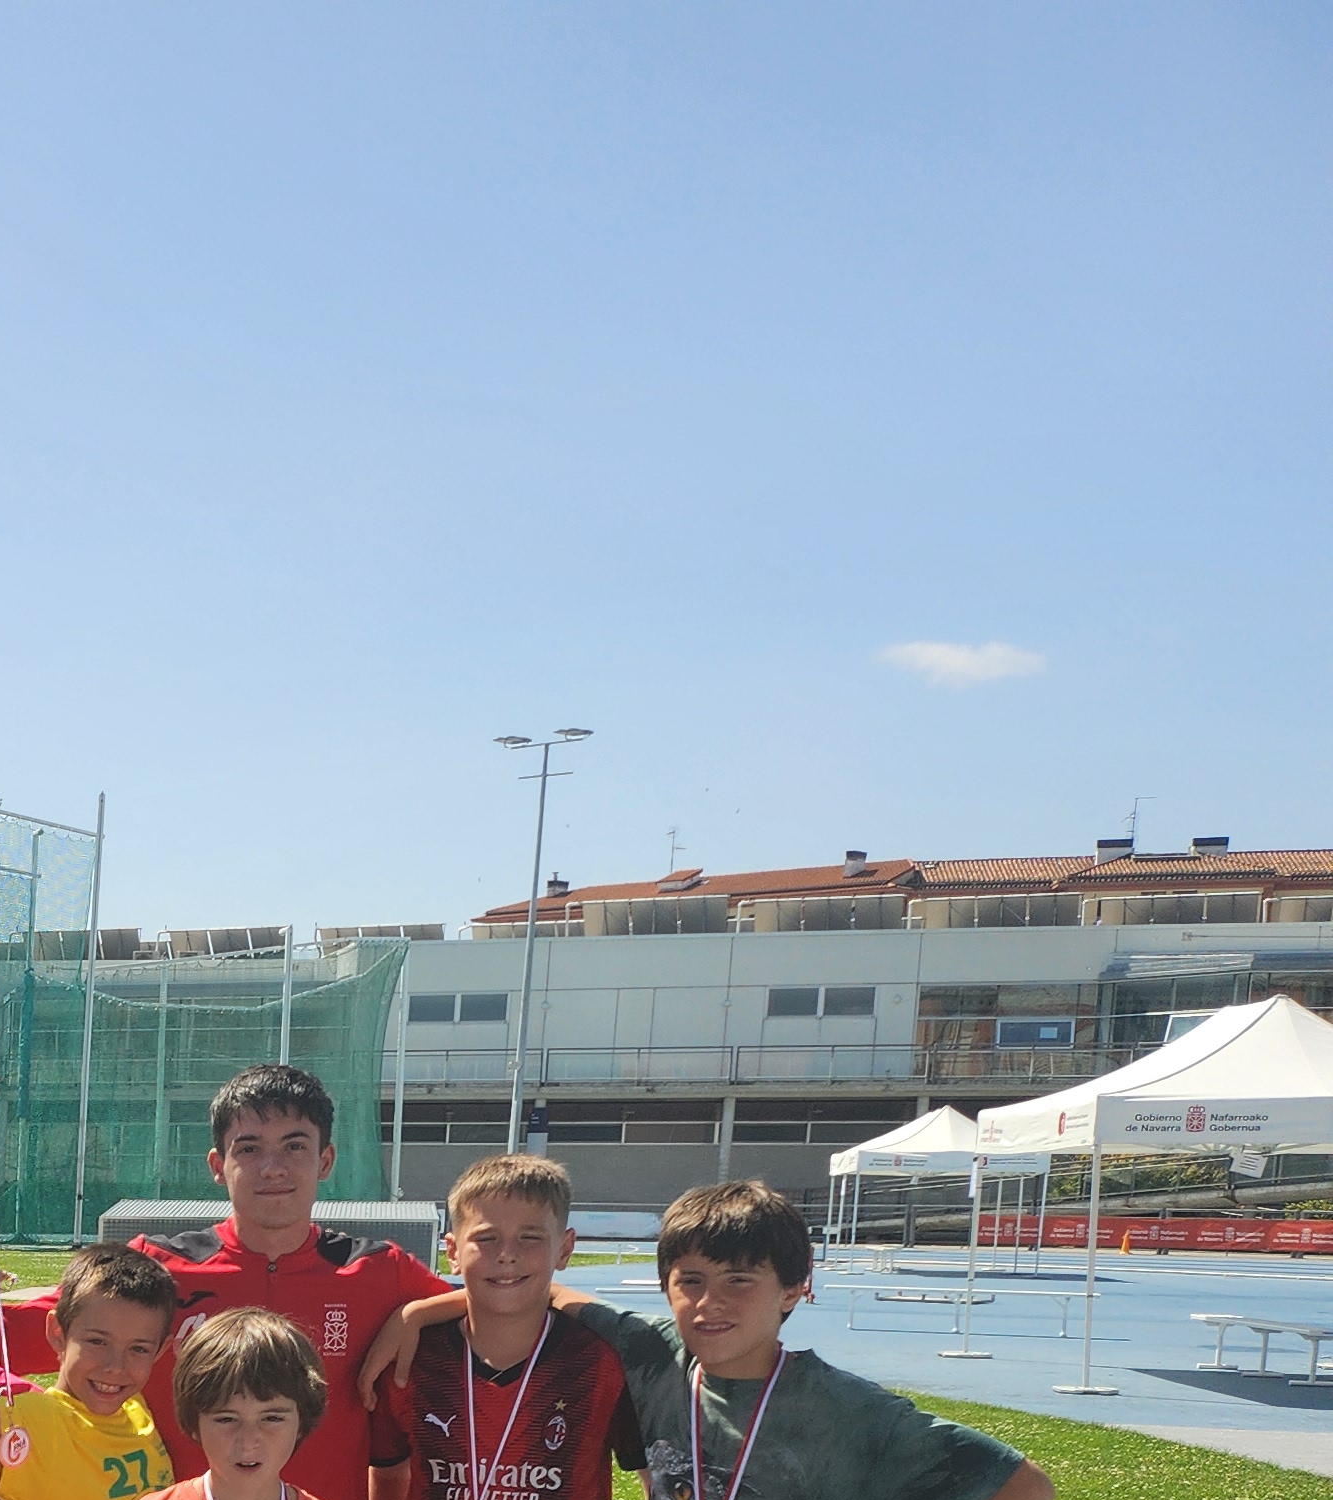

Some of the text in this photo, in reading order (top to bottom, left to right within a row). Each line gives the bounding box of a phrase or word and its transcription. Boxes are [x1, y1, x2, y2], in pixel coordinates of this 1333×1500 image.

[1135, 1113, 1182, 1122] Gobierno
[1210, 1113, 1269, 1122] Nafarroako
[1125, 1124, 1181, 1132] de Navarra
[1210, 1124, 1261, 1132] Gobernua
[104, 1449, 150, 1499] 27
[428, 1458, 562, 1491] Emirates
